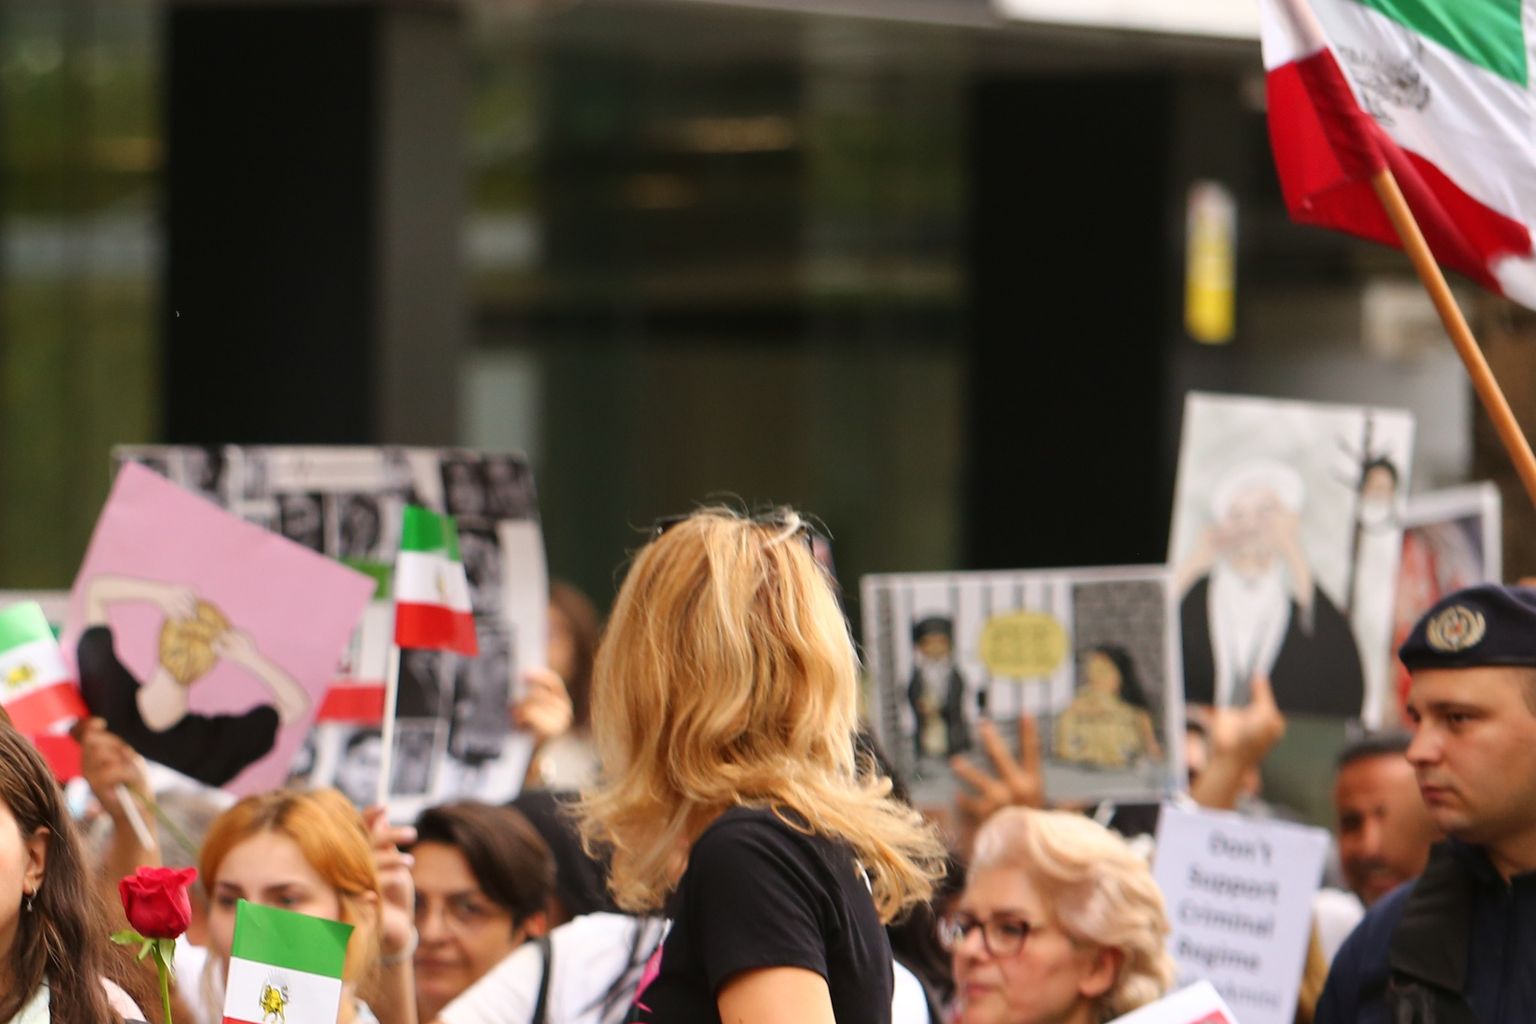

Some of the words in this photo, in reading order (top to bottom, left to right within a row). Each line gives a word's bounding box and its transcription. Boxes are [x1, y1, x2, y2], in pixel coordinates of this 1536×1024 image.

[1207, 831, 1273, 864] Don't
[1187, 864, 1279, 903] Support
[1178, 900, 1276, 939] Criminal
[1177, 935, 1261, 972] Regime
